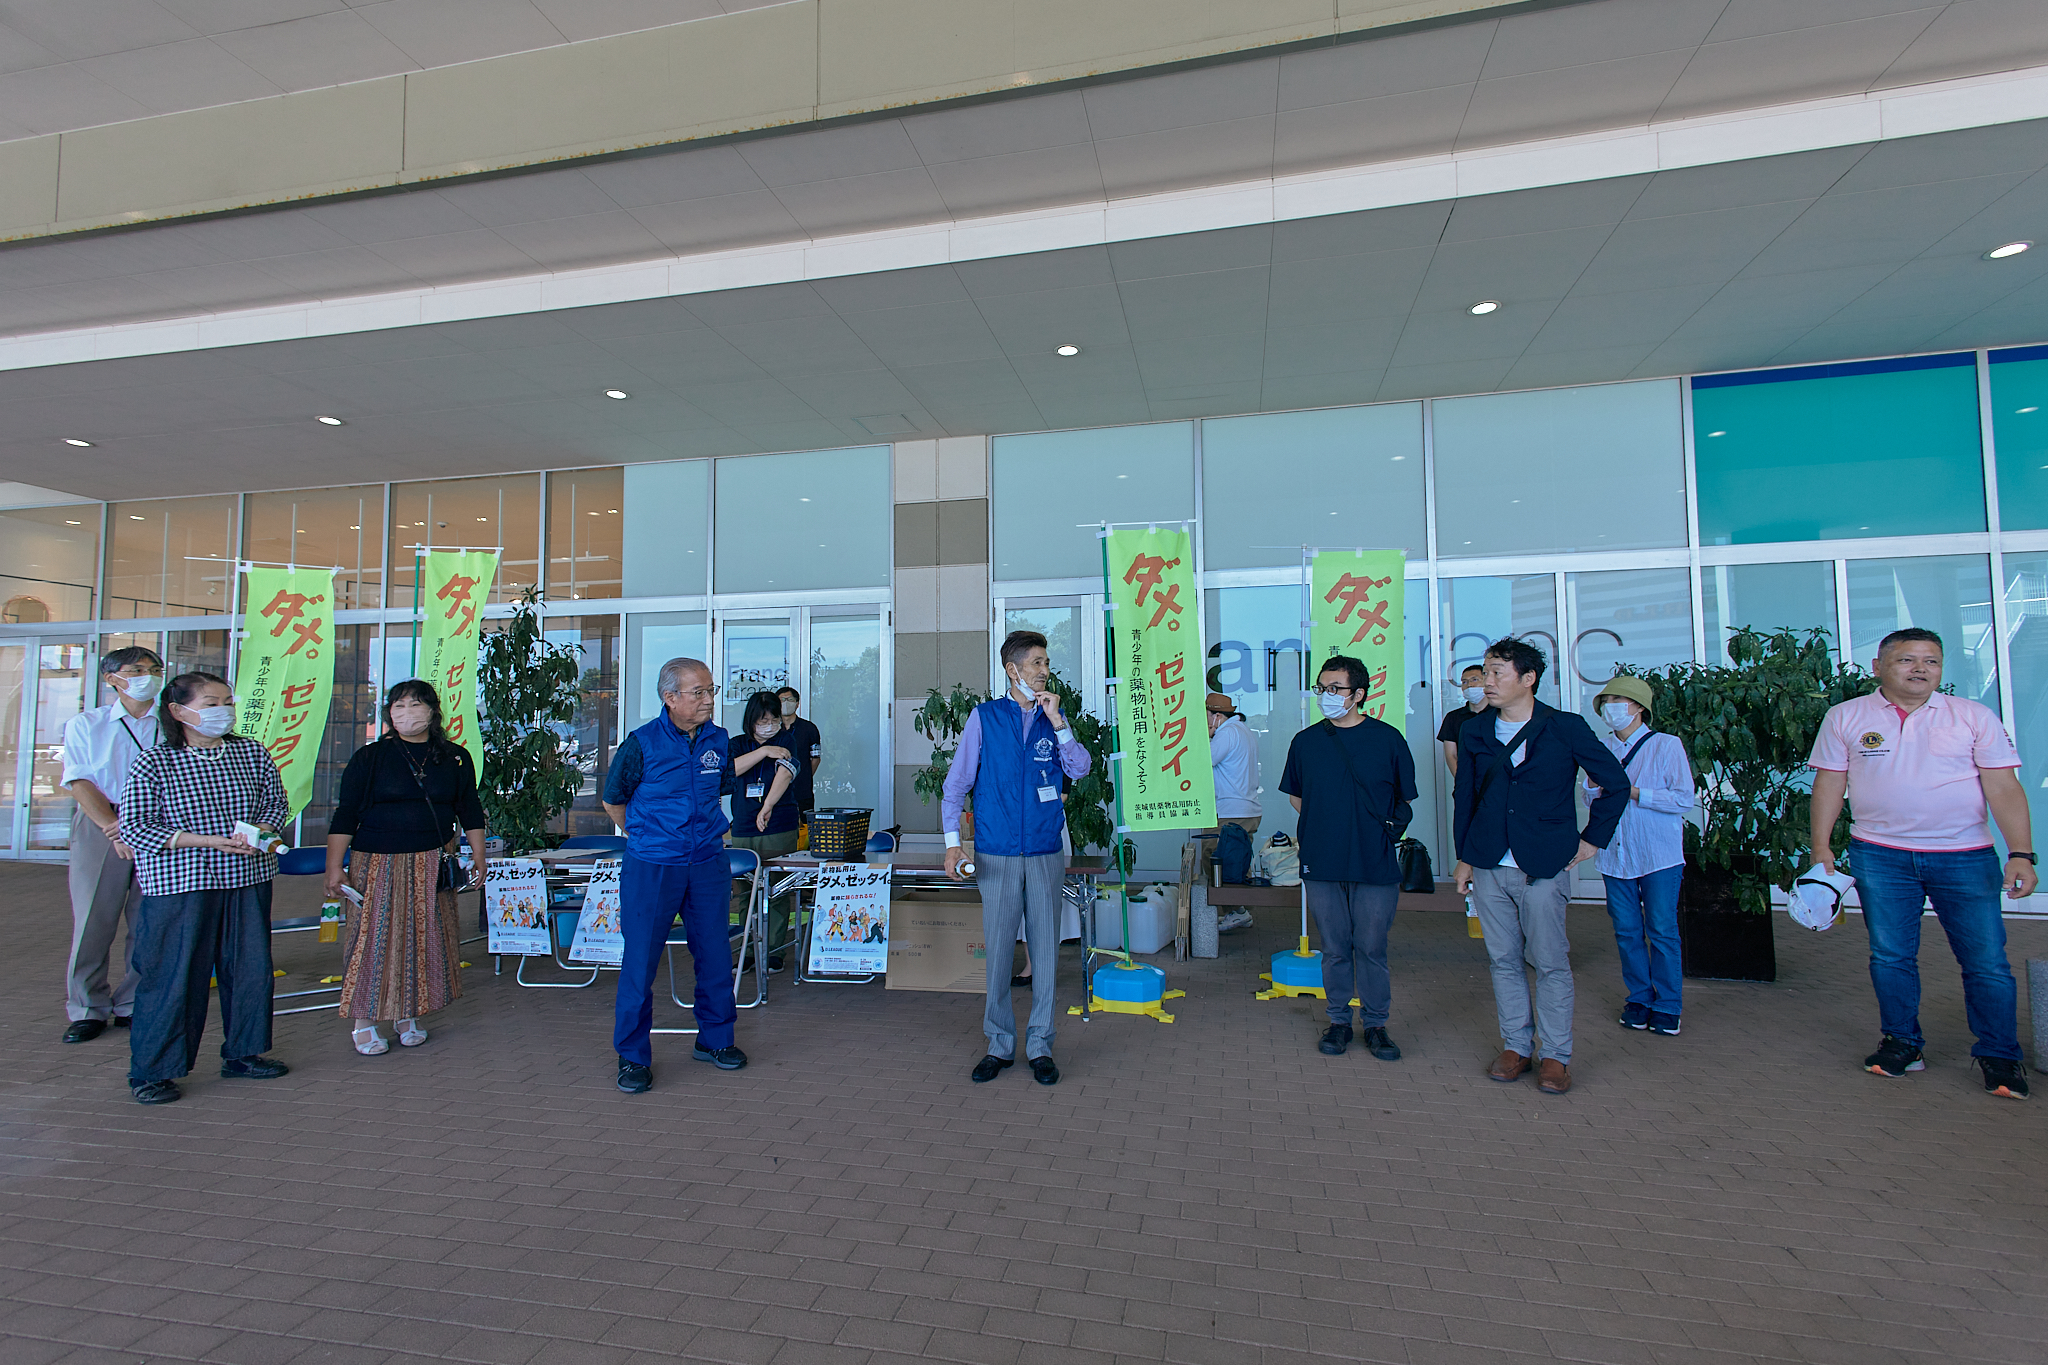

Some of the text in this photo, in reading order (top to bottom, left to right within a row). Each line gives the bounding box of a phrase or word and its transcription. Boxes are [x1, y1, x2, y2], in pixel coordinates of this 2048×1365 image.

[260, 589, 325, 660] ダメ。
[1123, 552, 1184, 632] ダメ。
[1324, 572, 1392, 648] ダメ。
[1328, 645, 1340, 657] 青
[240, 656, 273, 736] 青少年の薬物乱
[266, 677, 316, 771] ゼッタ
[1129, 628, 1148, 794] 青少年の薬物乱用をなくそう
[1155, 651, 1192, 792] ゼッタイ。
[1362, 665, 1387, 721] ゼッ
[486, 867, 544, 882] ダメ。ゼッタイ
[592, 870, 621, 884] ダメ。
